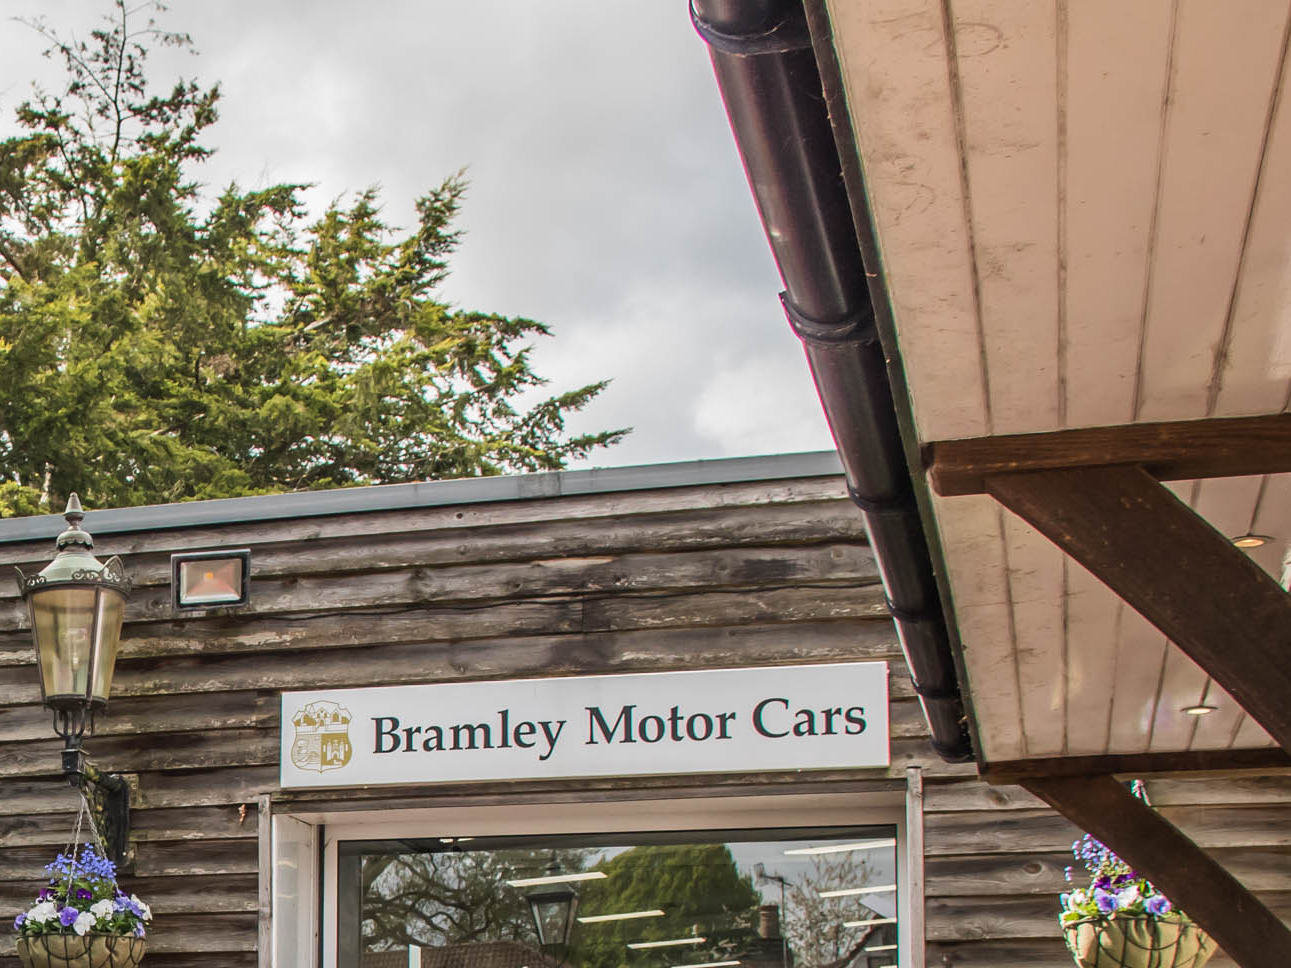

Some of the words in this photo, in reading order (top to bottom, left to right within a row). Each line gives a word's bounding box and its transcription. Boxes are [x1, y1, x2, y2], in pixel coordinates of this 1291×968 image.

[372, 710, 567, 760] Bramley
[585, 704, 737, 745] Motor
[752, 697, 867, 739] Cars
